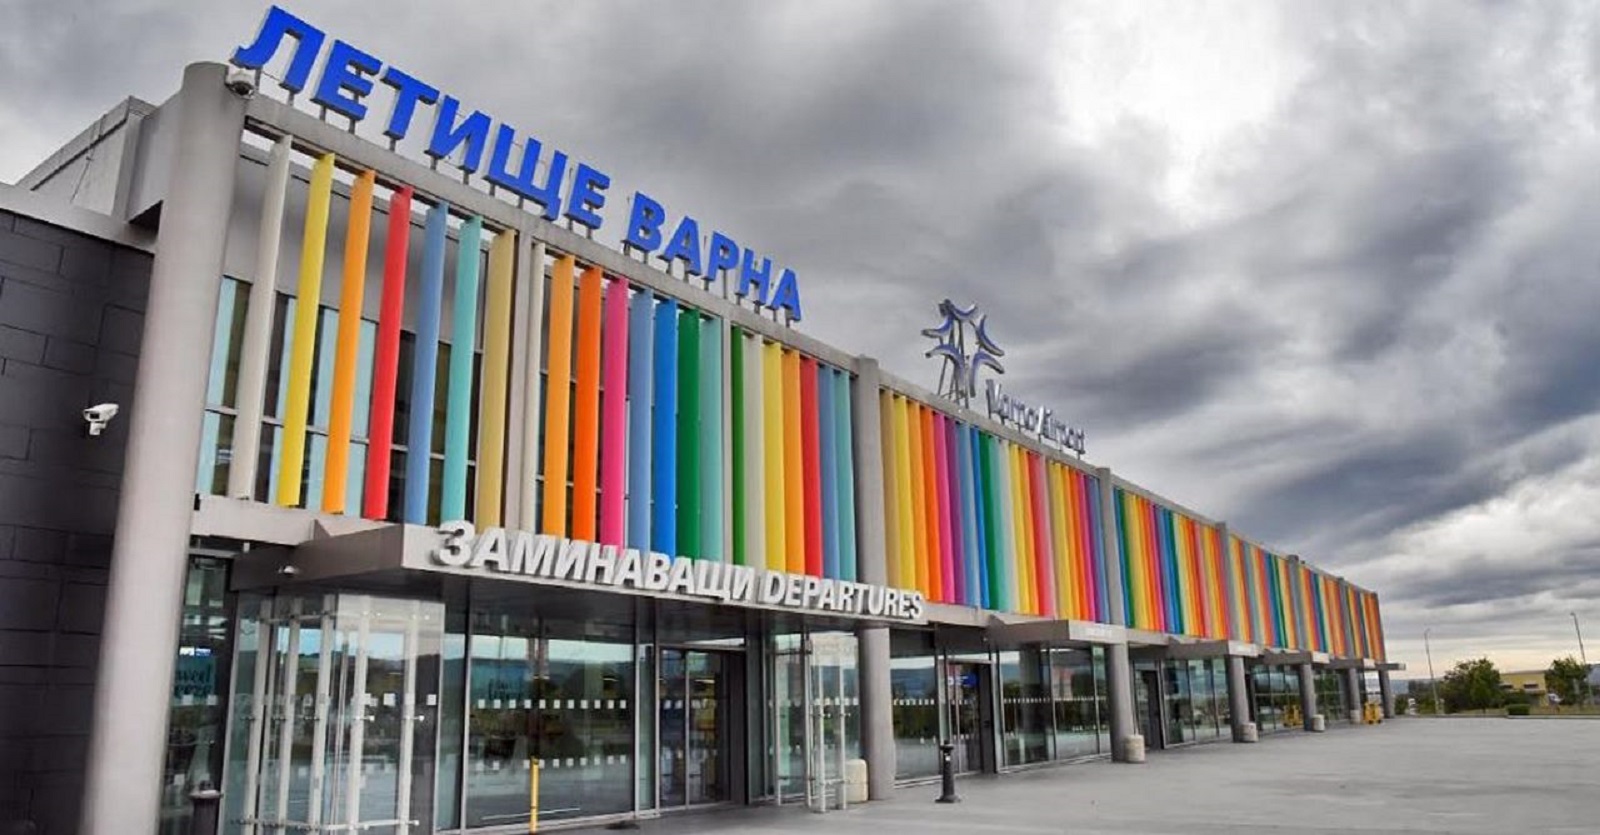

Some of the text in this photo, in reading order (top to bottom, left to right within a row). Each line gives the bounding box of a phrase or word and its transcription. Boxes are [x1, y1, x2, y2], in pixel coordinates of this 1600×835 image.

[233, 5, 802, 322] ЛЕТИЩЕ ВАРНА
[986, 379, 1036, 431] Varna
[435, 520, 924, 620] ЗАМИНАВАЩИ DEPARTURES
